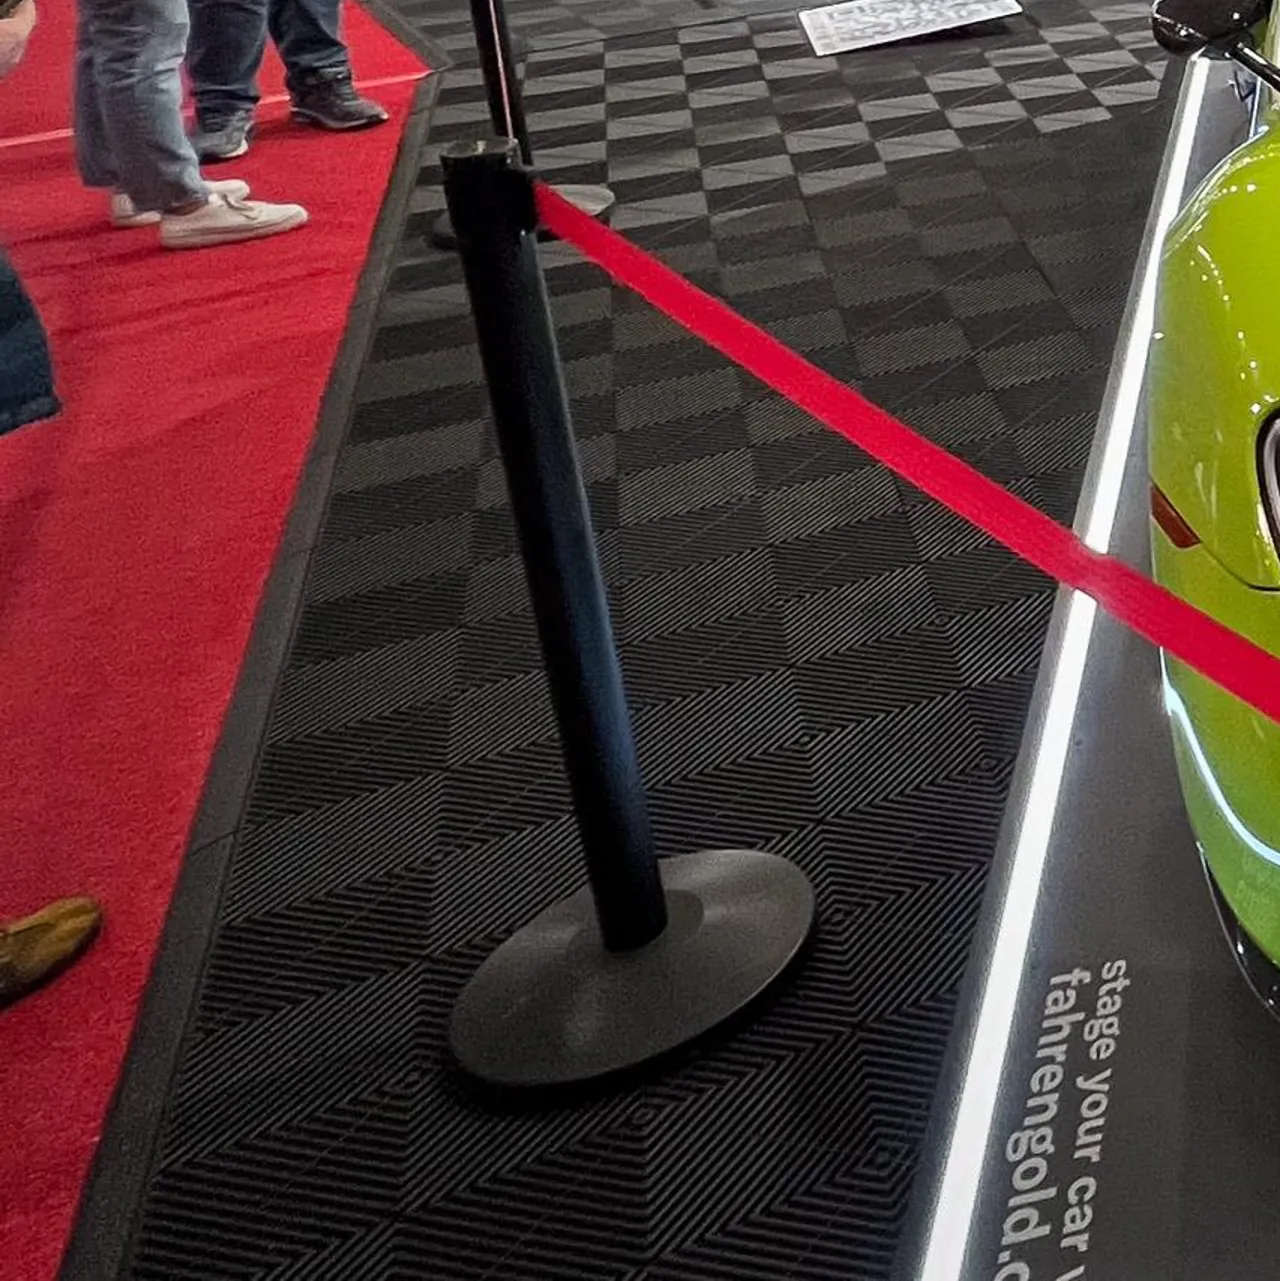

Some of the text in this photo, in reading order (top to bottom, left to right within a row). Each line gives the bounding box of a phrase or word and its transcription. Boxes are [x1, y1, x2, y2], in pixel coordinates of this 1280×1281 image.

[1083, 959, 1131, 1060] stage
[1073, 1068, 1113, 1163] your
[1060, 1176, 1098, 1252] car
